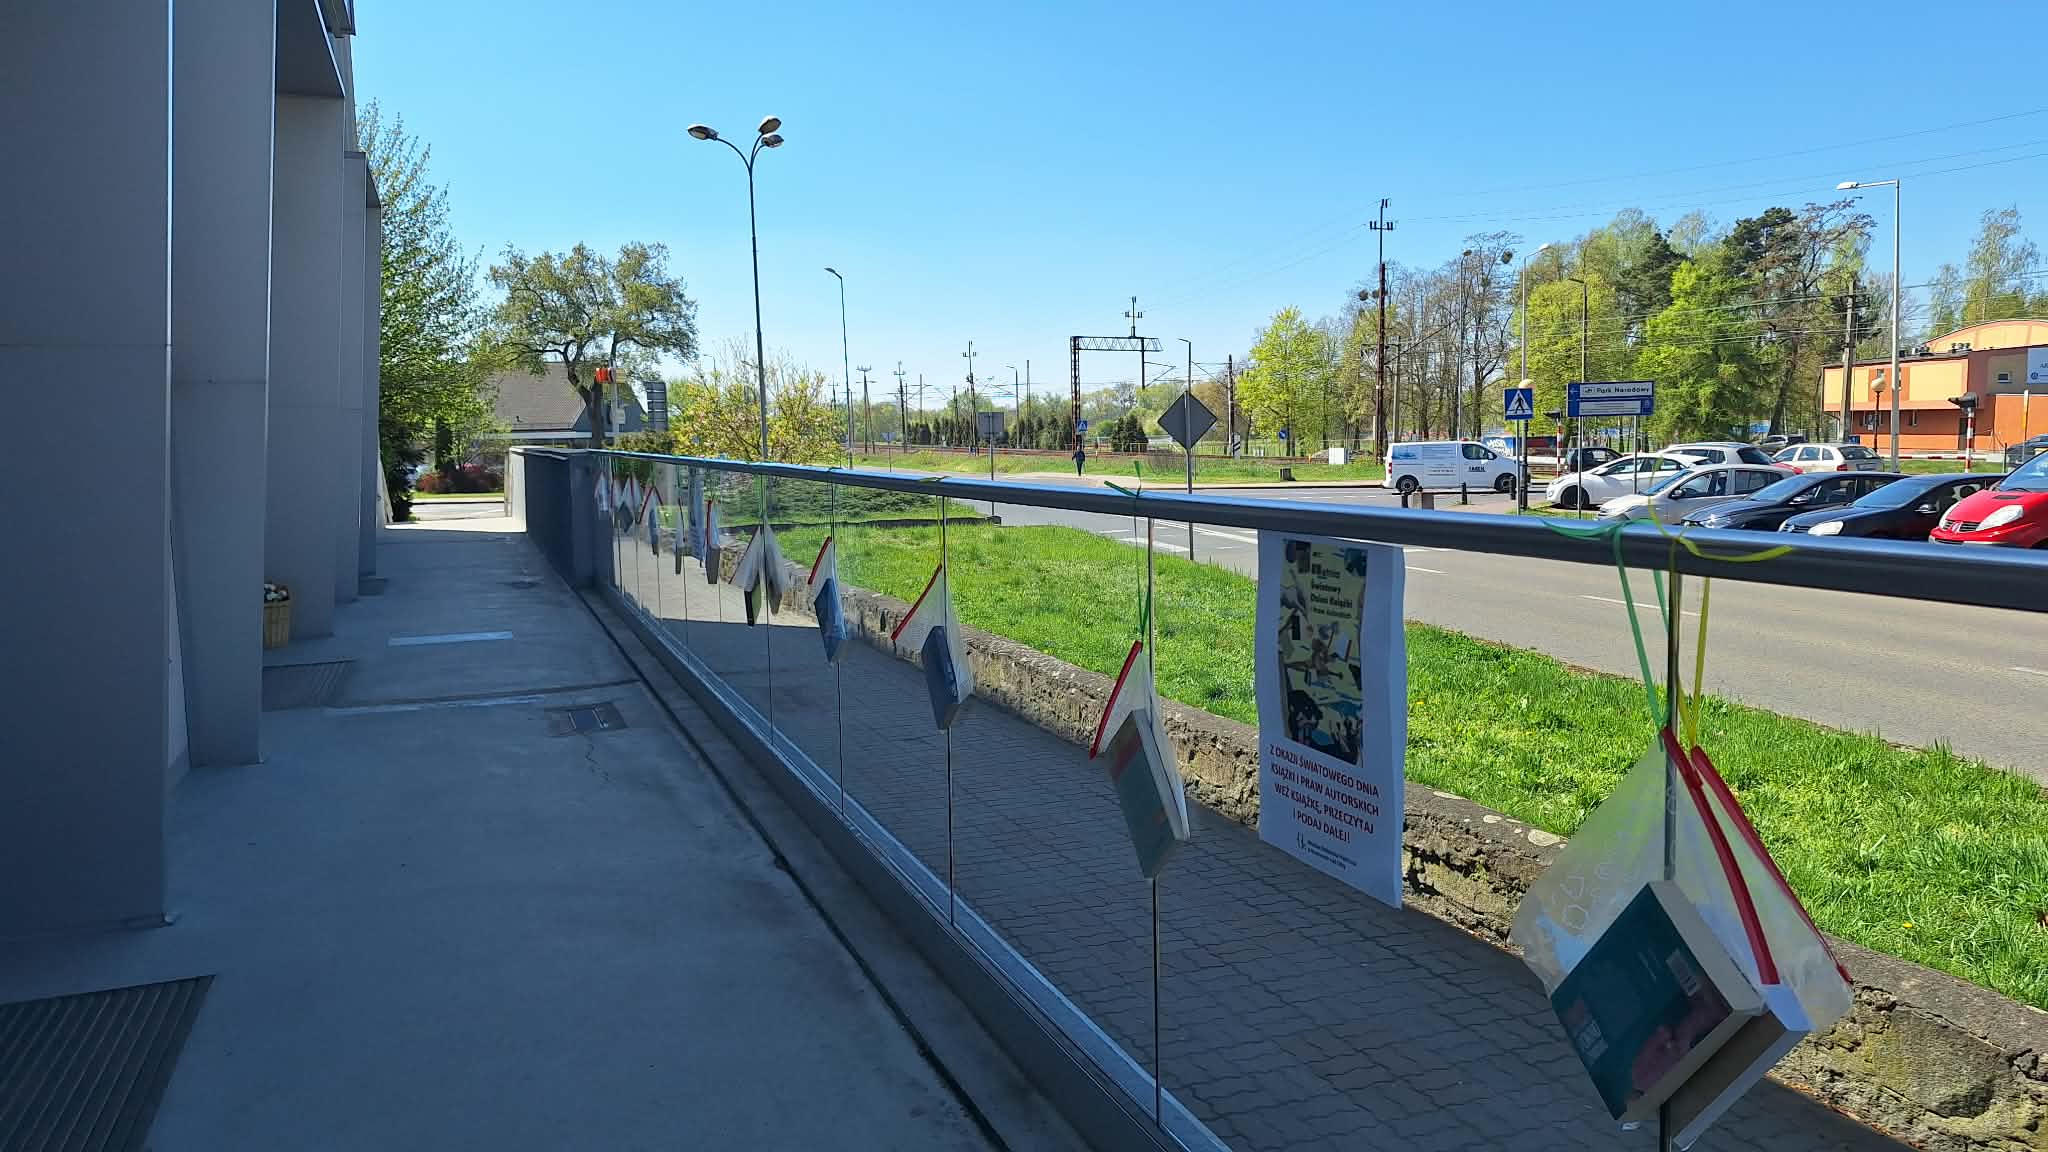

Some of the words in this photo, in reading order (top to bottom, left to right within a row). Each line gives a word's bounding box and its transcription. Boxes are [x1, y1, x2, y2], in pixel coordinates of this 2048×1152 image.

[1270, 744, 1275, 754] Z
[1299, 757, 1354, 787] ŚWIATOWEGO
[1356, 779, 1379, 798] DNIA
[1300, 775, 1324, 794] PRAW
[1325, 787, 1379, 816] AUTORSKICH
[1297, 810, 1321, 830] PODAJ
[1323, 823, 1351, 844] DALEJ!
[1323, 804, 1374, 834] PRZECZYTAJ
